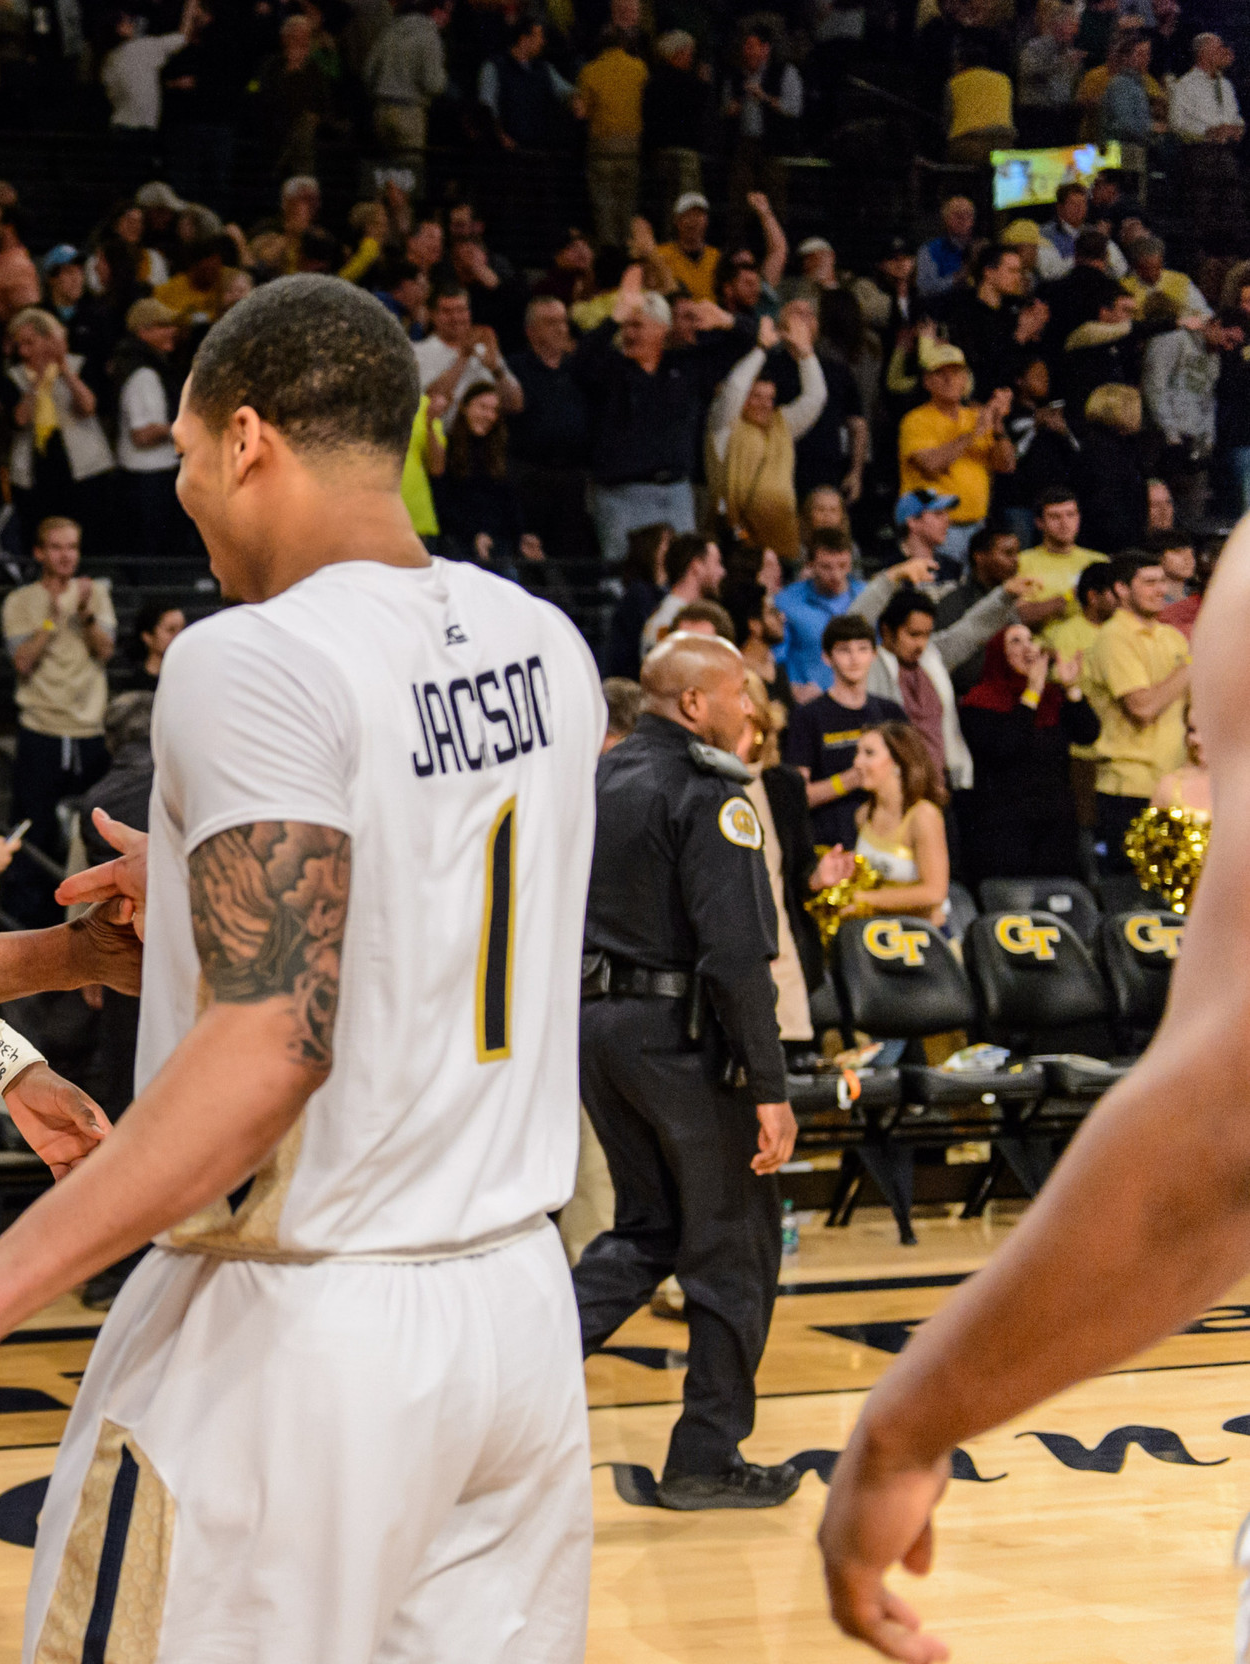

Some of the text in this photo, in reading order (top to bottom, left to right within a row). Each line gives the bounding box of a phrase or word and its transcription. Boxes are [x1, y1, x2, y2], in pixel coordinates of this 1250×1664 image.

[475, 792, 517, 1064] 1
[863, 919, 930, 966] GT
[995, 915, 1060, 960] GT
